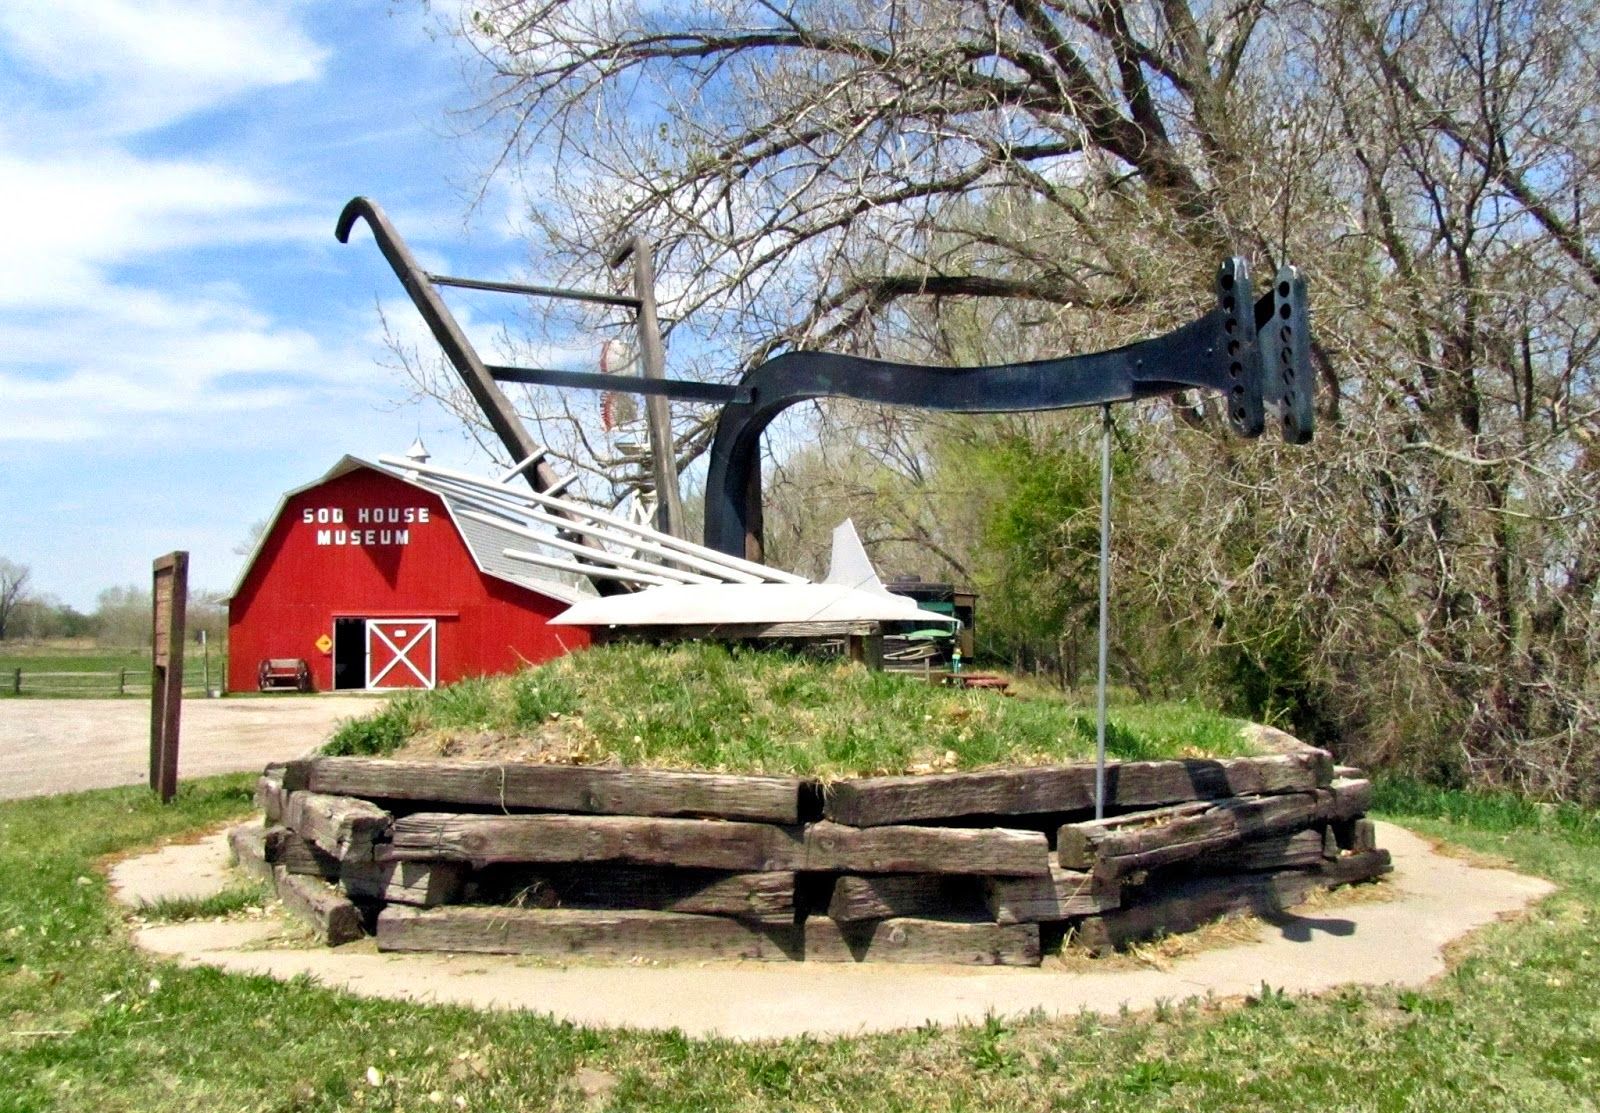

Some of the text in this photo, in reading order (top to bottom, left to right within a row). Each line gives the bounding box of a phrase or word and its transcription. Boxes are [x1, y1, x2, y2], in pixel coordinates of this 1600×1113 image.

[303, 508, 430, 523] SOD HOUSE
[317, 530, 409, 545] MUSEUM
